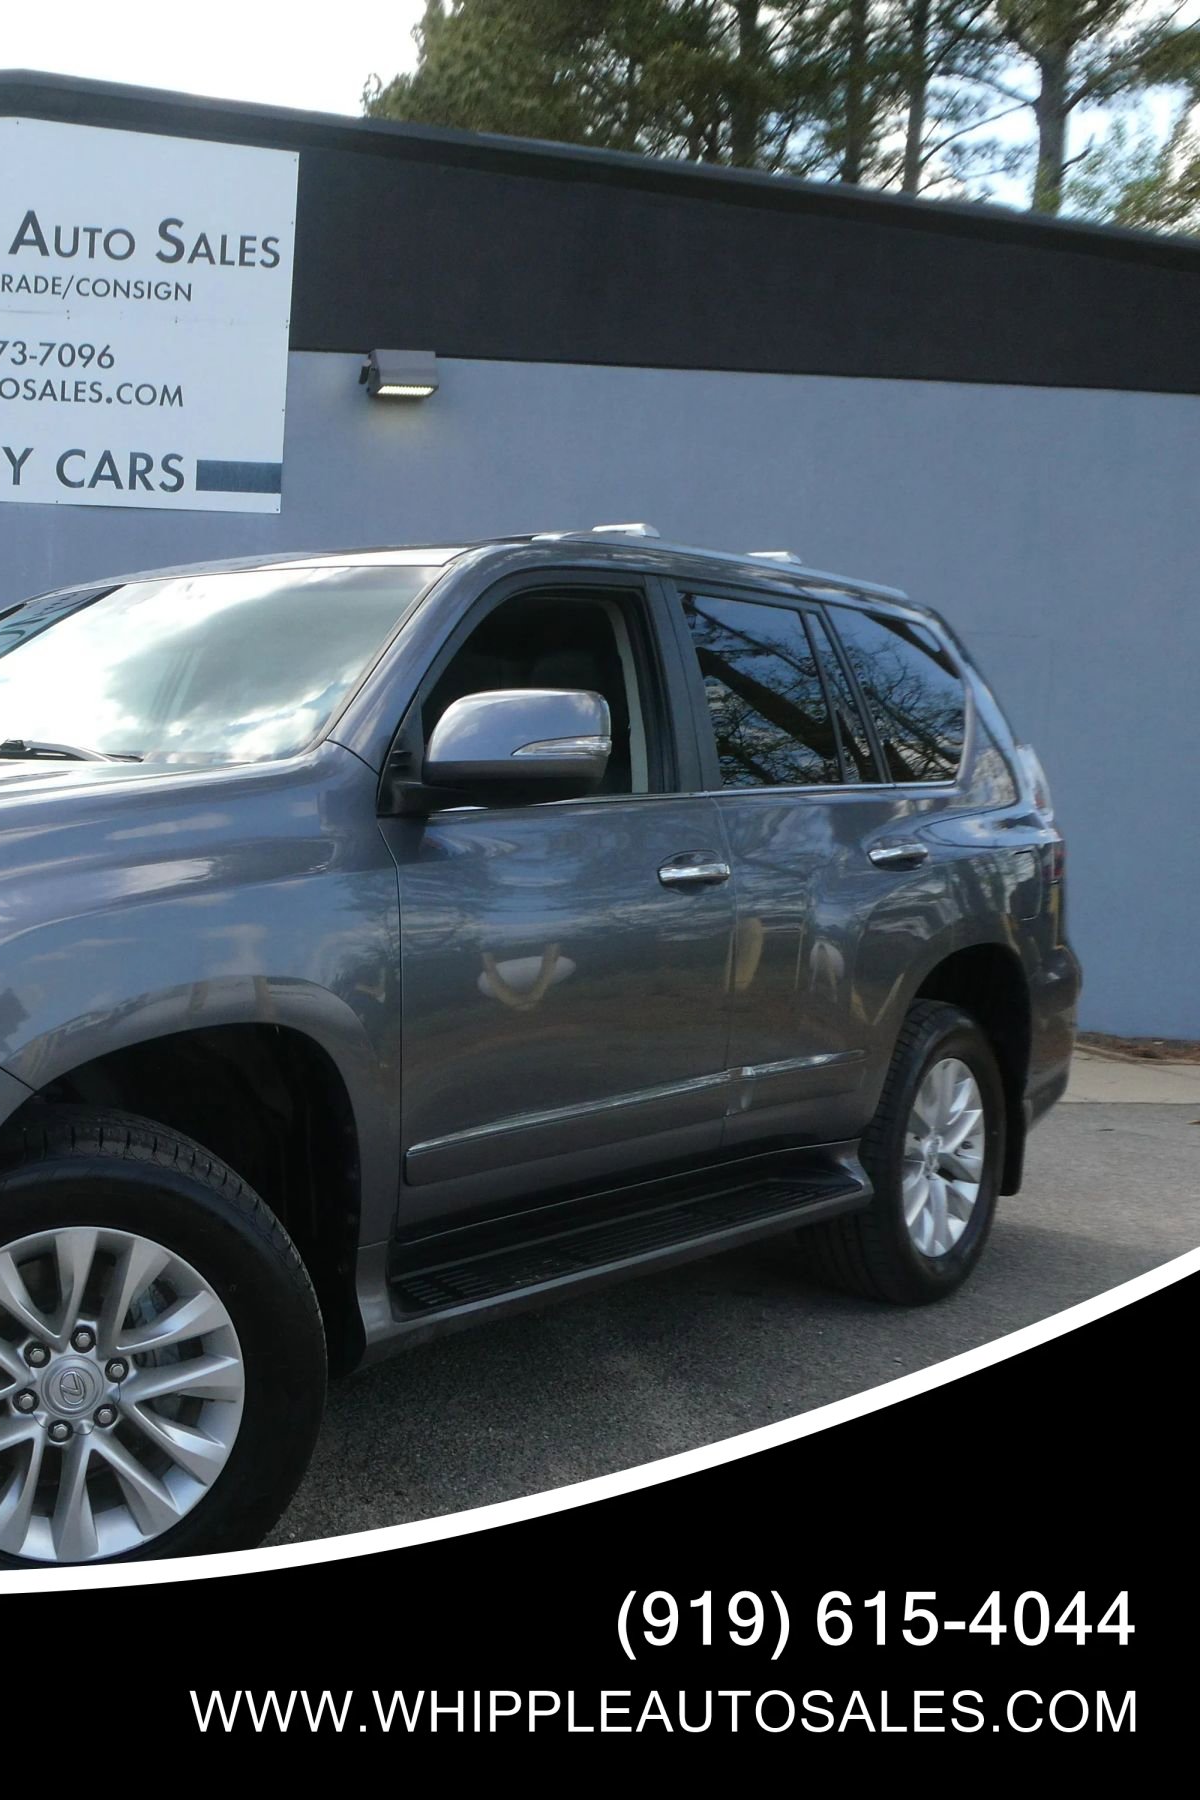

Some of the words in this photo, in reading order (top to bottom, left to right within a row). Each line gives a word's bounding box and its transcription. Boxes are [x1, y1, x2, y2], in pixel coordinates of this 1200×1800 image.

[8, 210, 136, 261] AUTO
[155, 218, 281, 269] SALES
[55, 448, 185, 492] CARS
